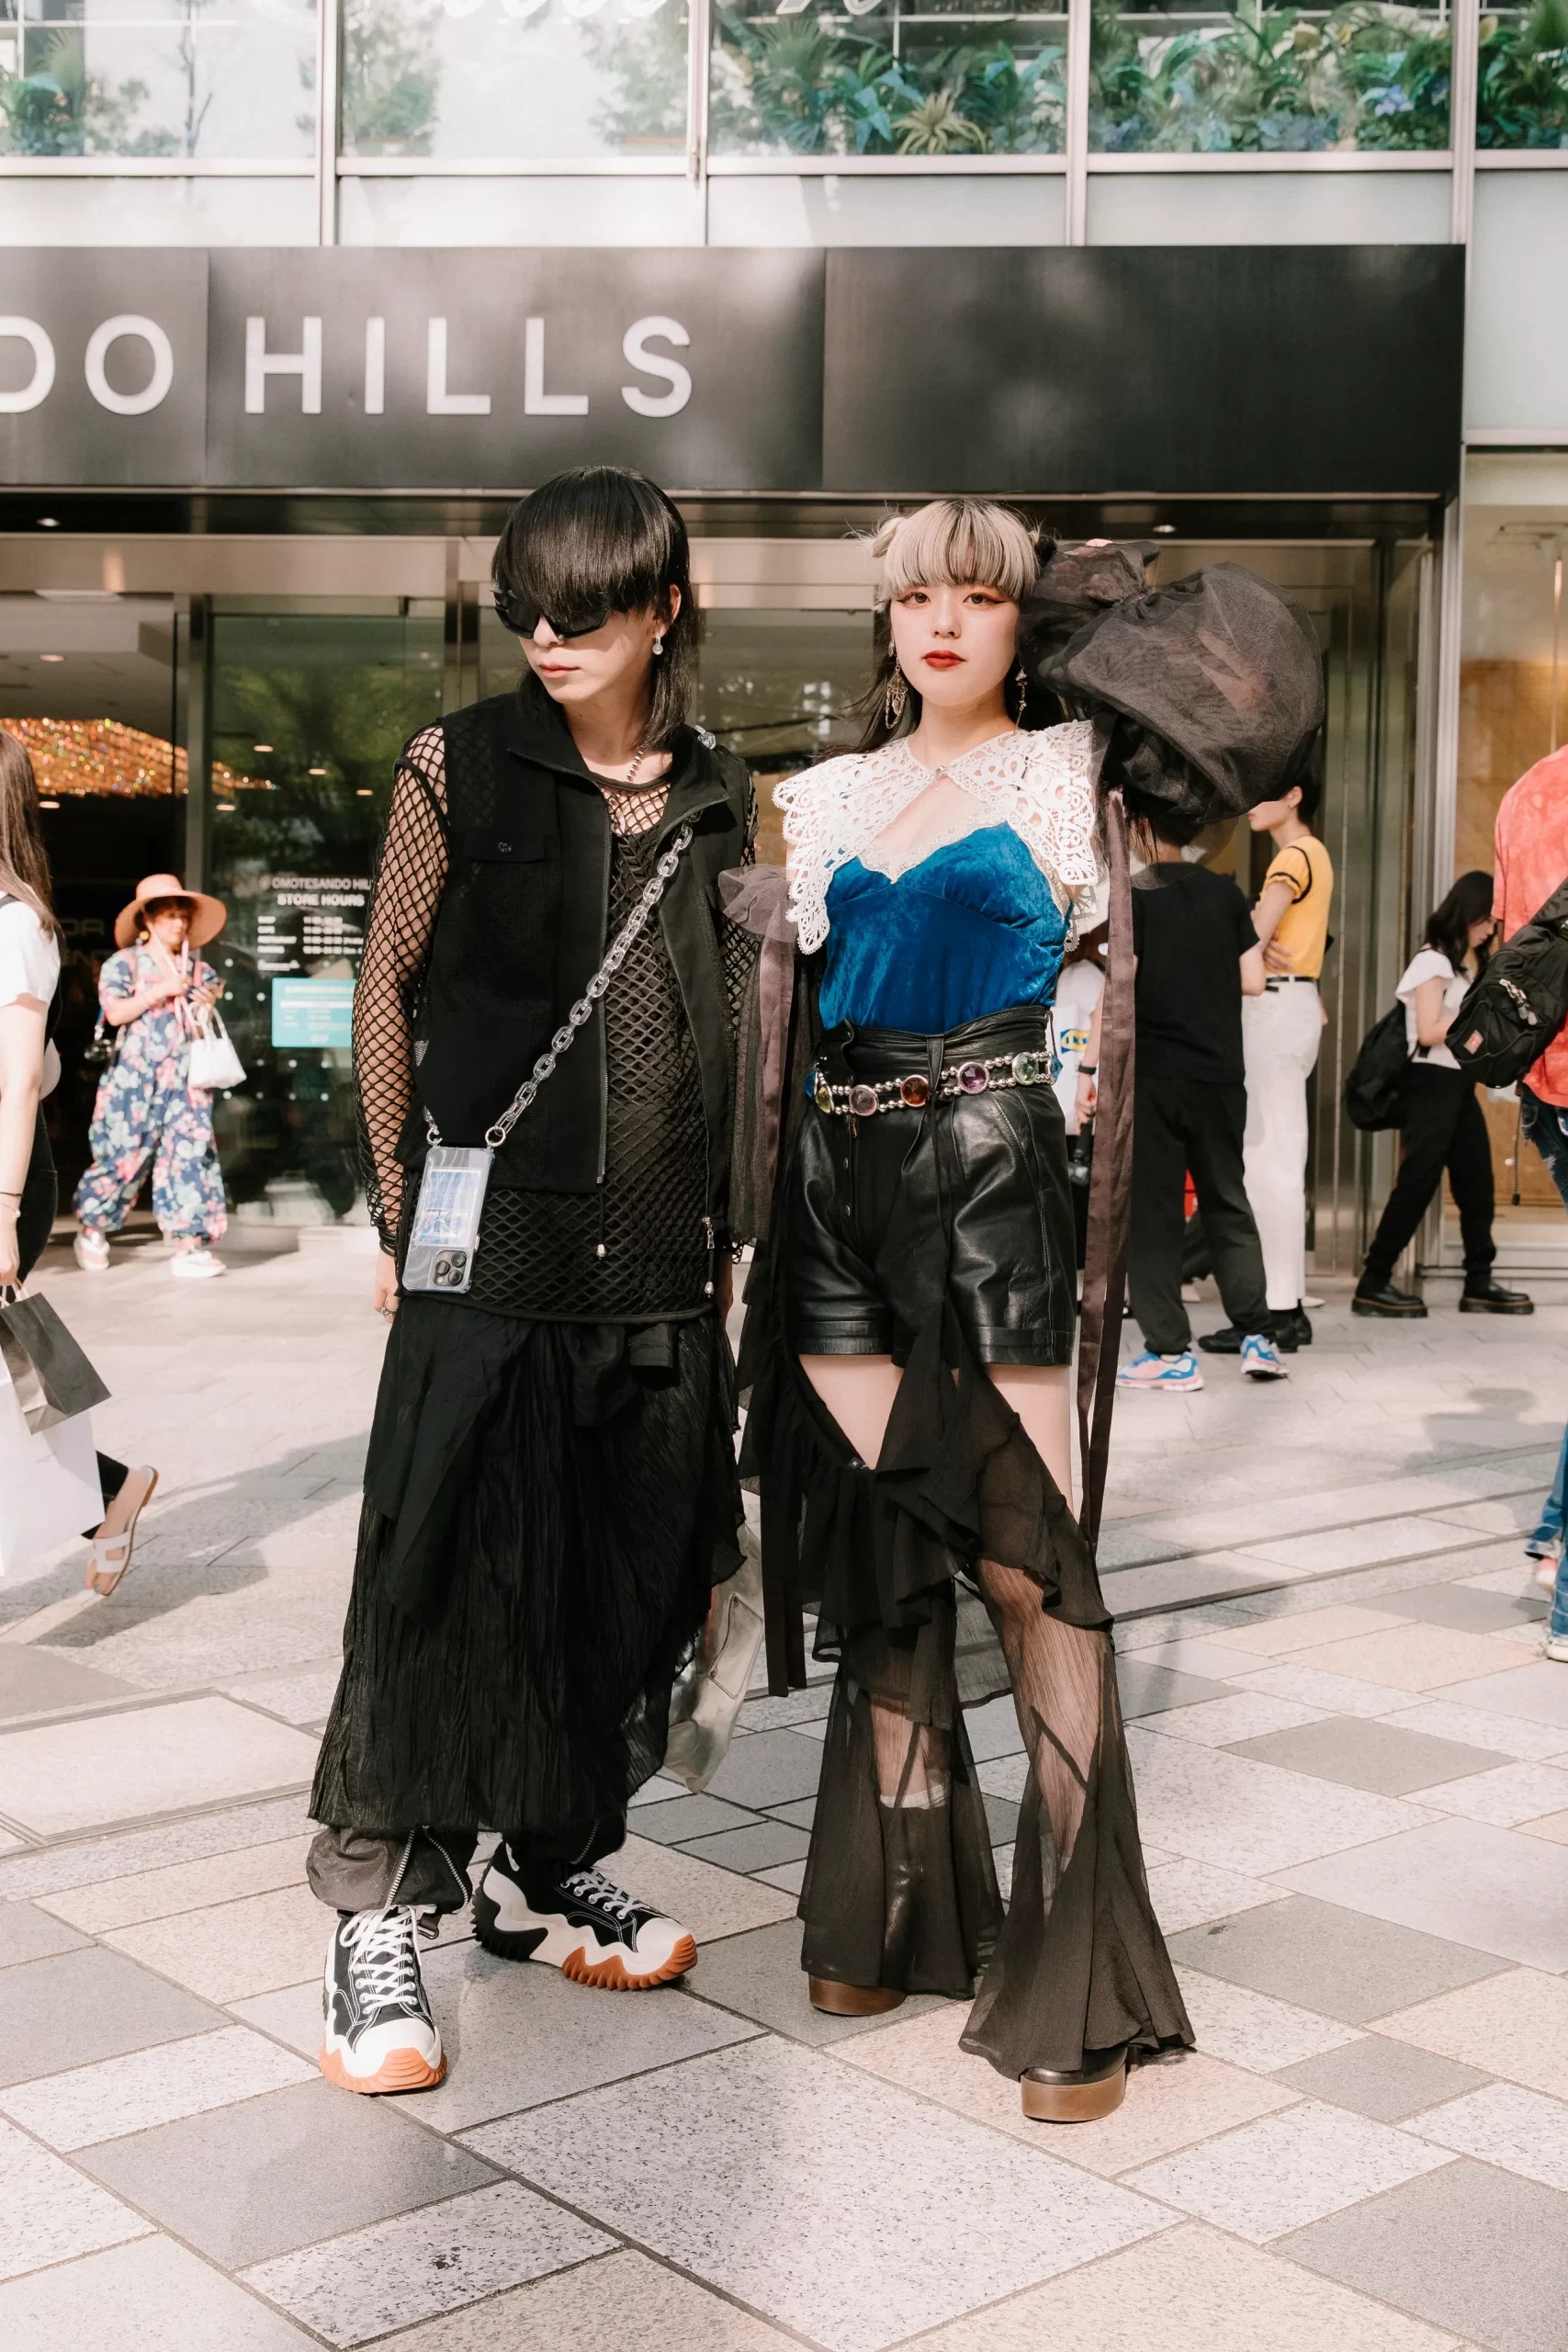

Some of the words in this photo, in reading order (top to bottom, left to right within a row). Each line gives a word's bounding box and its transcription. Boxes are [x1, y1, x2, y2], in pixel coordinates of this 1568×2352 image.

[0, 315, 174, 414] DO
[245, 315, 691, 416] HILLS
[272, 876, 352, 890] OMOTESANDO
[277, 893, 320, 906] STORE
[321, 894, 366, 907] HOURS
